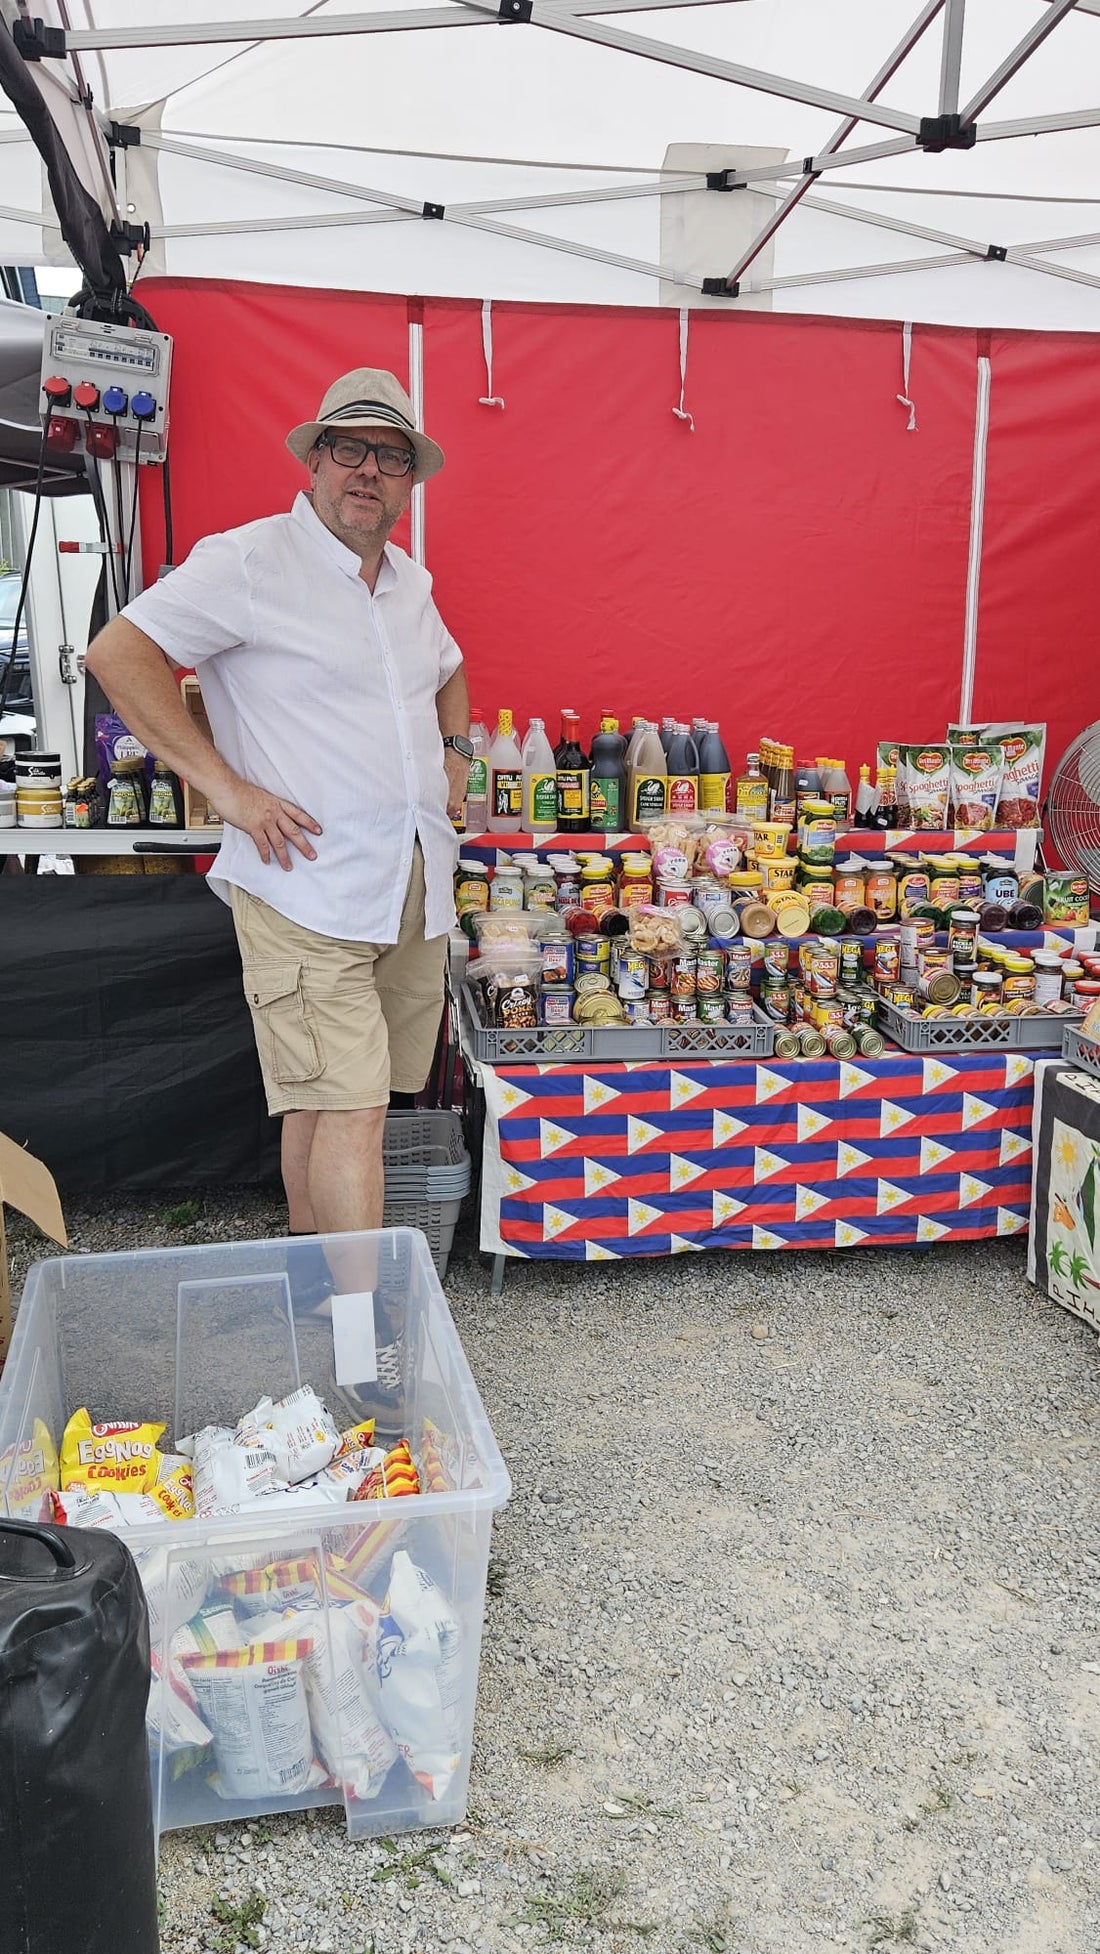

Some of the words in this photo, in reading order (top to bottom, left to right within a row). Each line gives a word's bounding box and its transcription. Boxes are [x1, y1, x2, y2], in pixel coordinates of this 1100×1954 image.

[1003, 760, 1040, 782] aghetti
[995, 890, 1015, 898] UBE
[628, 962, 644, 971] MEG
[79, 1439, 153, 1466] EggNog
[88, 1464, 147, 1481] Cookies
[163, 1477, 193, 1513] EggNo
